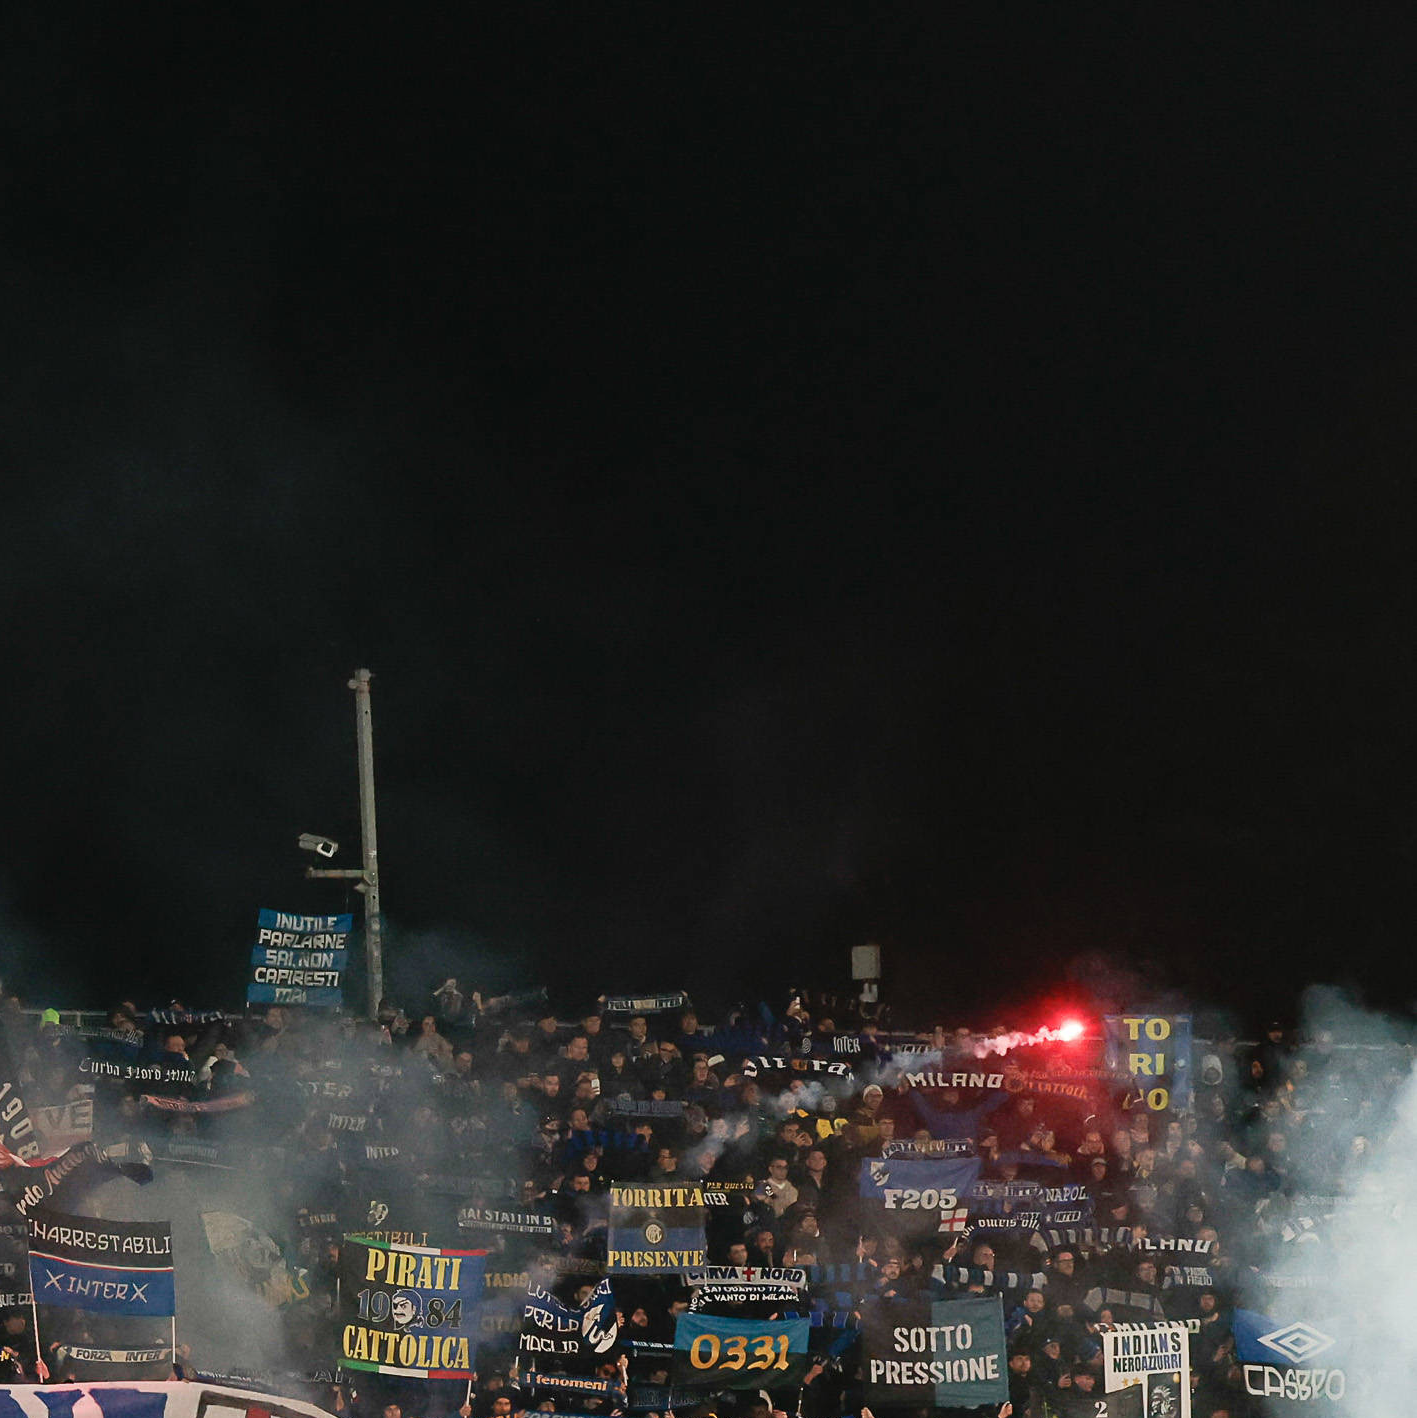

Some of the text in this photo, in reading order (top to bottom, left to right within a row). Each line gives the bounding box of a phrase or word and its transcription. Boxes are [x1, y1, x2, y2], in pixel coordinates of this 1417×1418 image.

[276, 912, 337, 932] INUTILE
[259, 929, 345, 950] PARLARNE
[254, 967, 339, 987] CAPIRESTI
[1123, 1017, 1170, 1041] TO
[833, 1035, 861, 1054] INTER
[1129, 1053, 1165, 1076] RI
[905, 1072, 1004, 1089] MILANO
[610, 1187, 705, 1208] TORRITA
[883, 1188, 957, 1210] F205
[366, 1247, 461, 1291] PIRATI
[608, 1249, 705, 1268] PRESENTE
[760, 1266, 803, 1282] NORD
[67, 1276, 130, 1300] INTER
[342, 1323, 470, 1369] CATTOLICA
[893, 1323, 973, 1353] SOTTO
[1113, 1331, 1182, 1358] INDIANS
[75, 1348, 113, 1361] FORZA
[690, 1334, 790, 1372] 0331
[1113, 1353, 1182, 1373] NEROAZZURRI
[869, 1354, 1000, 1385] PRESSIONE
[535, 1374, 609, 1392] fenomeni
